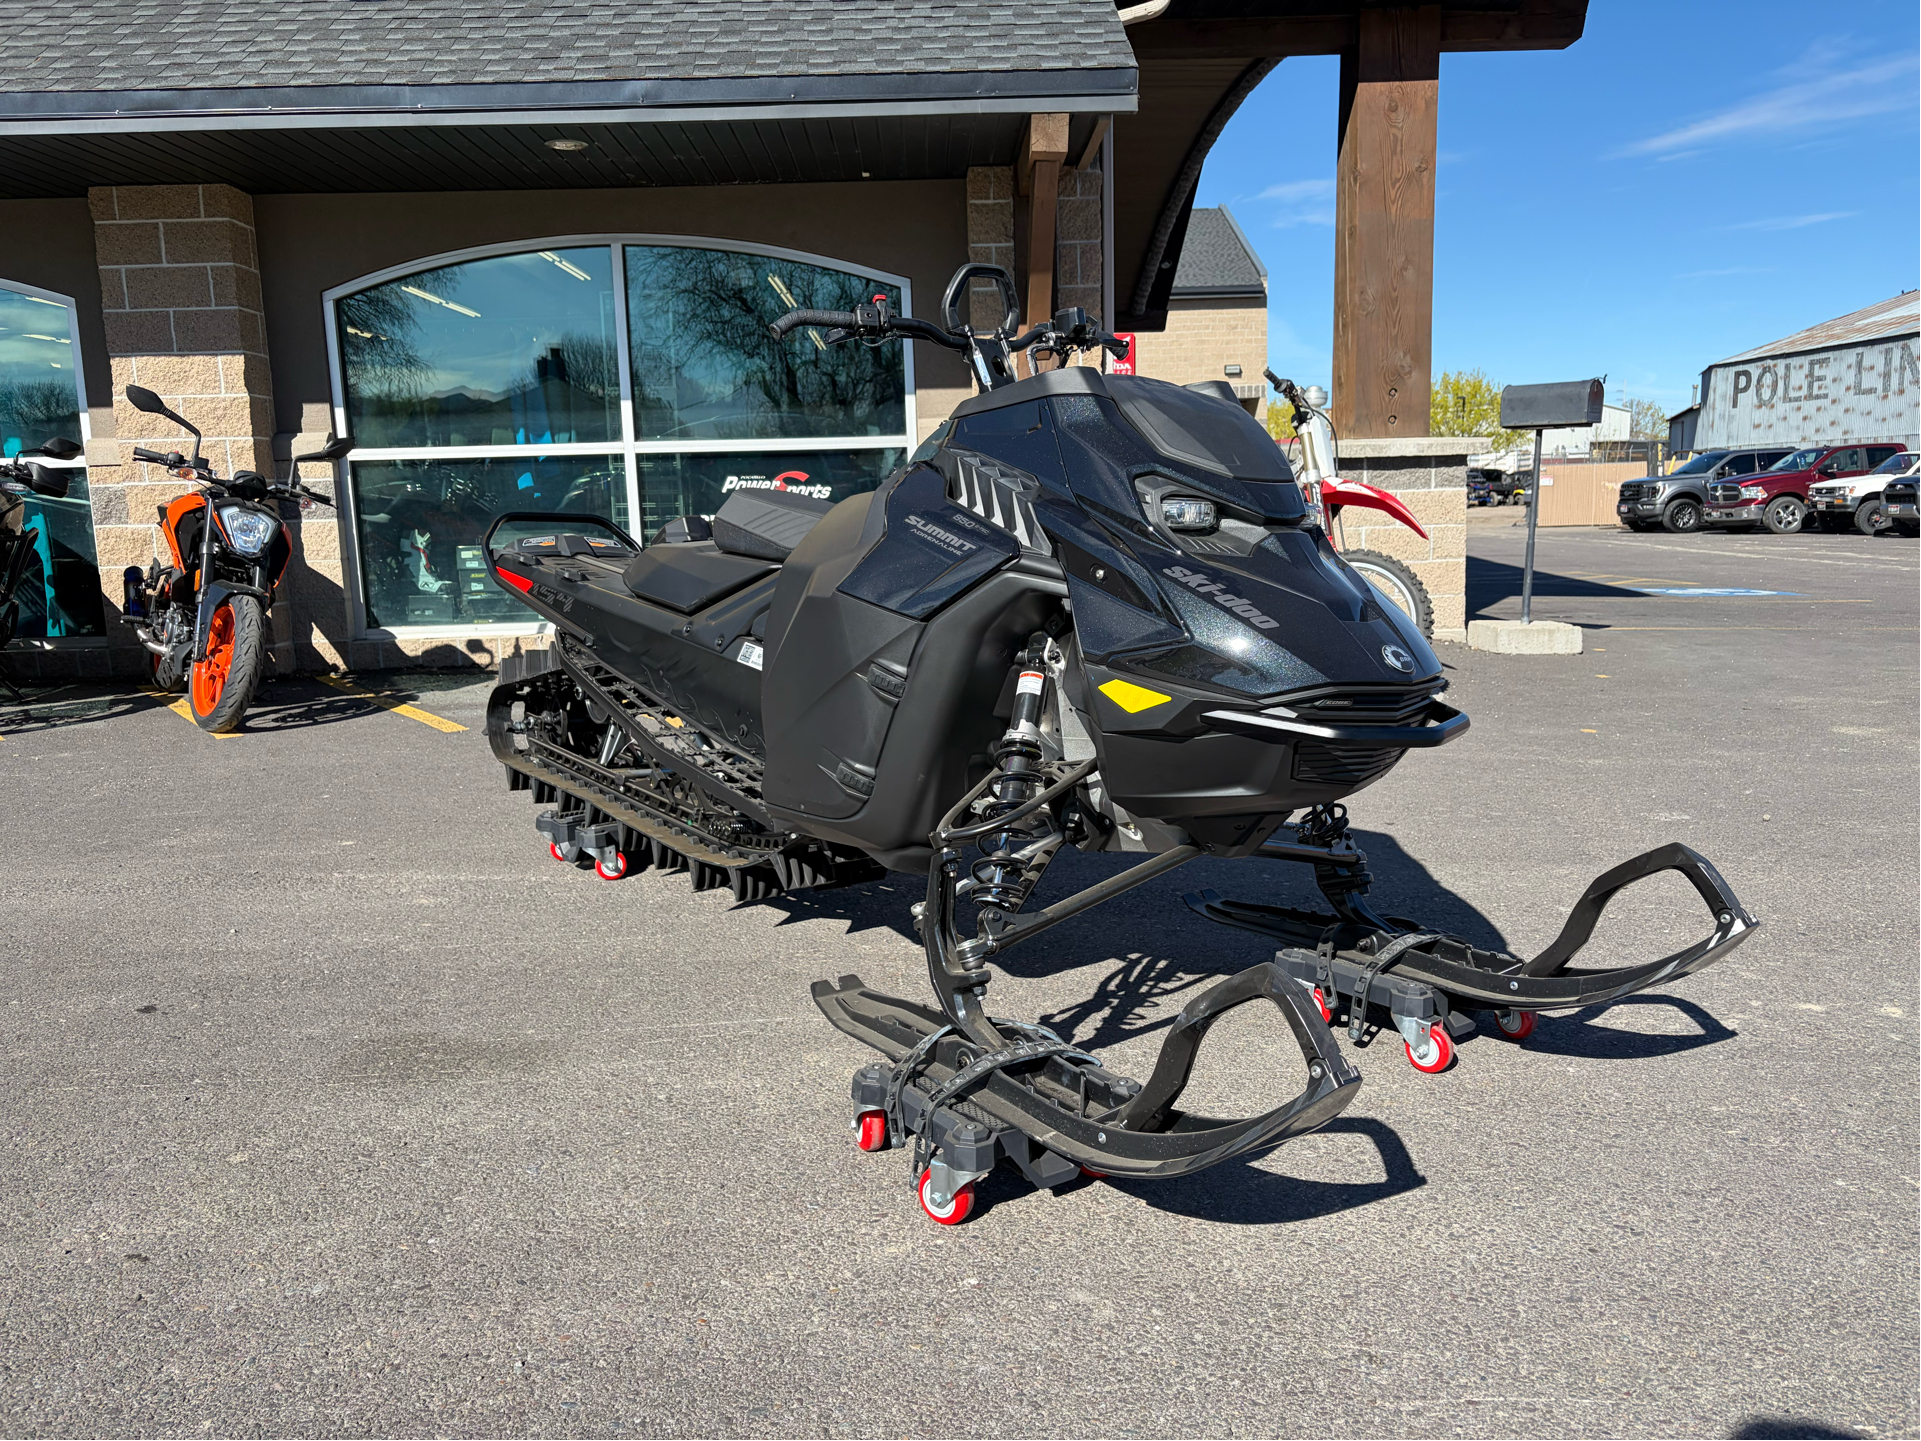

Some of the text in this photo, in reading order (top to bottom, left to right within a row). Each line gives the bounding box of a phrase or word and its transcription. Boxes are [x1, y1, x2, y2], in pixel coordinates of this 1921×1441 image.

[1732, 356, 1831, 409] POLE
[904, 514, 977, 552] SUMMIT
[952, 513, 975, 529] 850
[910, 528, 964, 557] ADRENALINE
